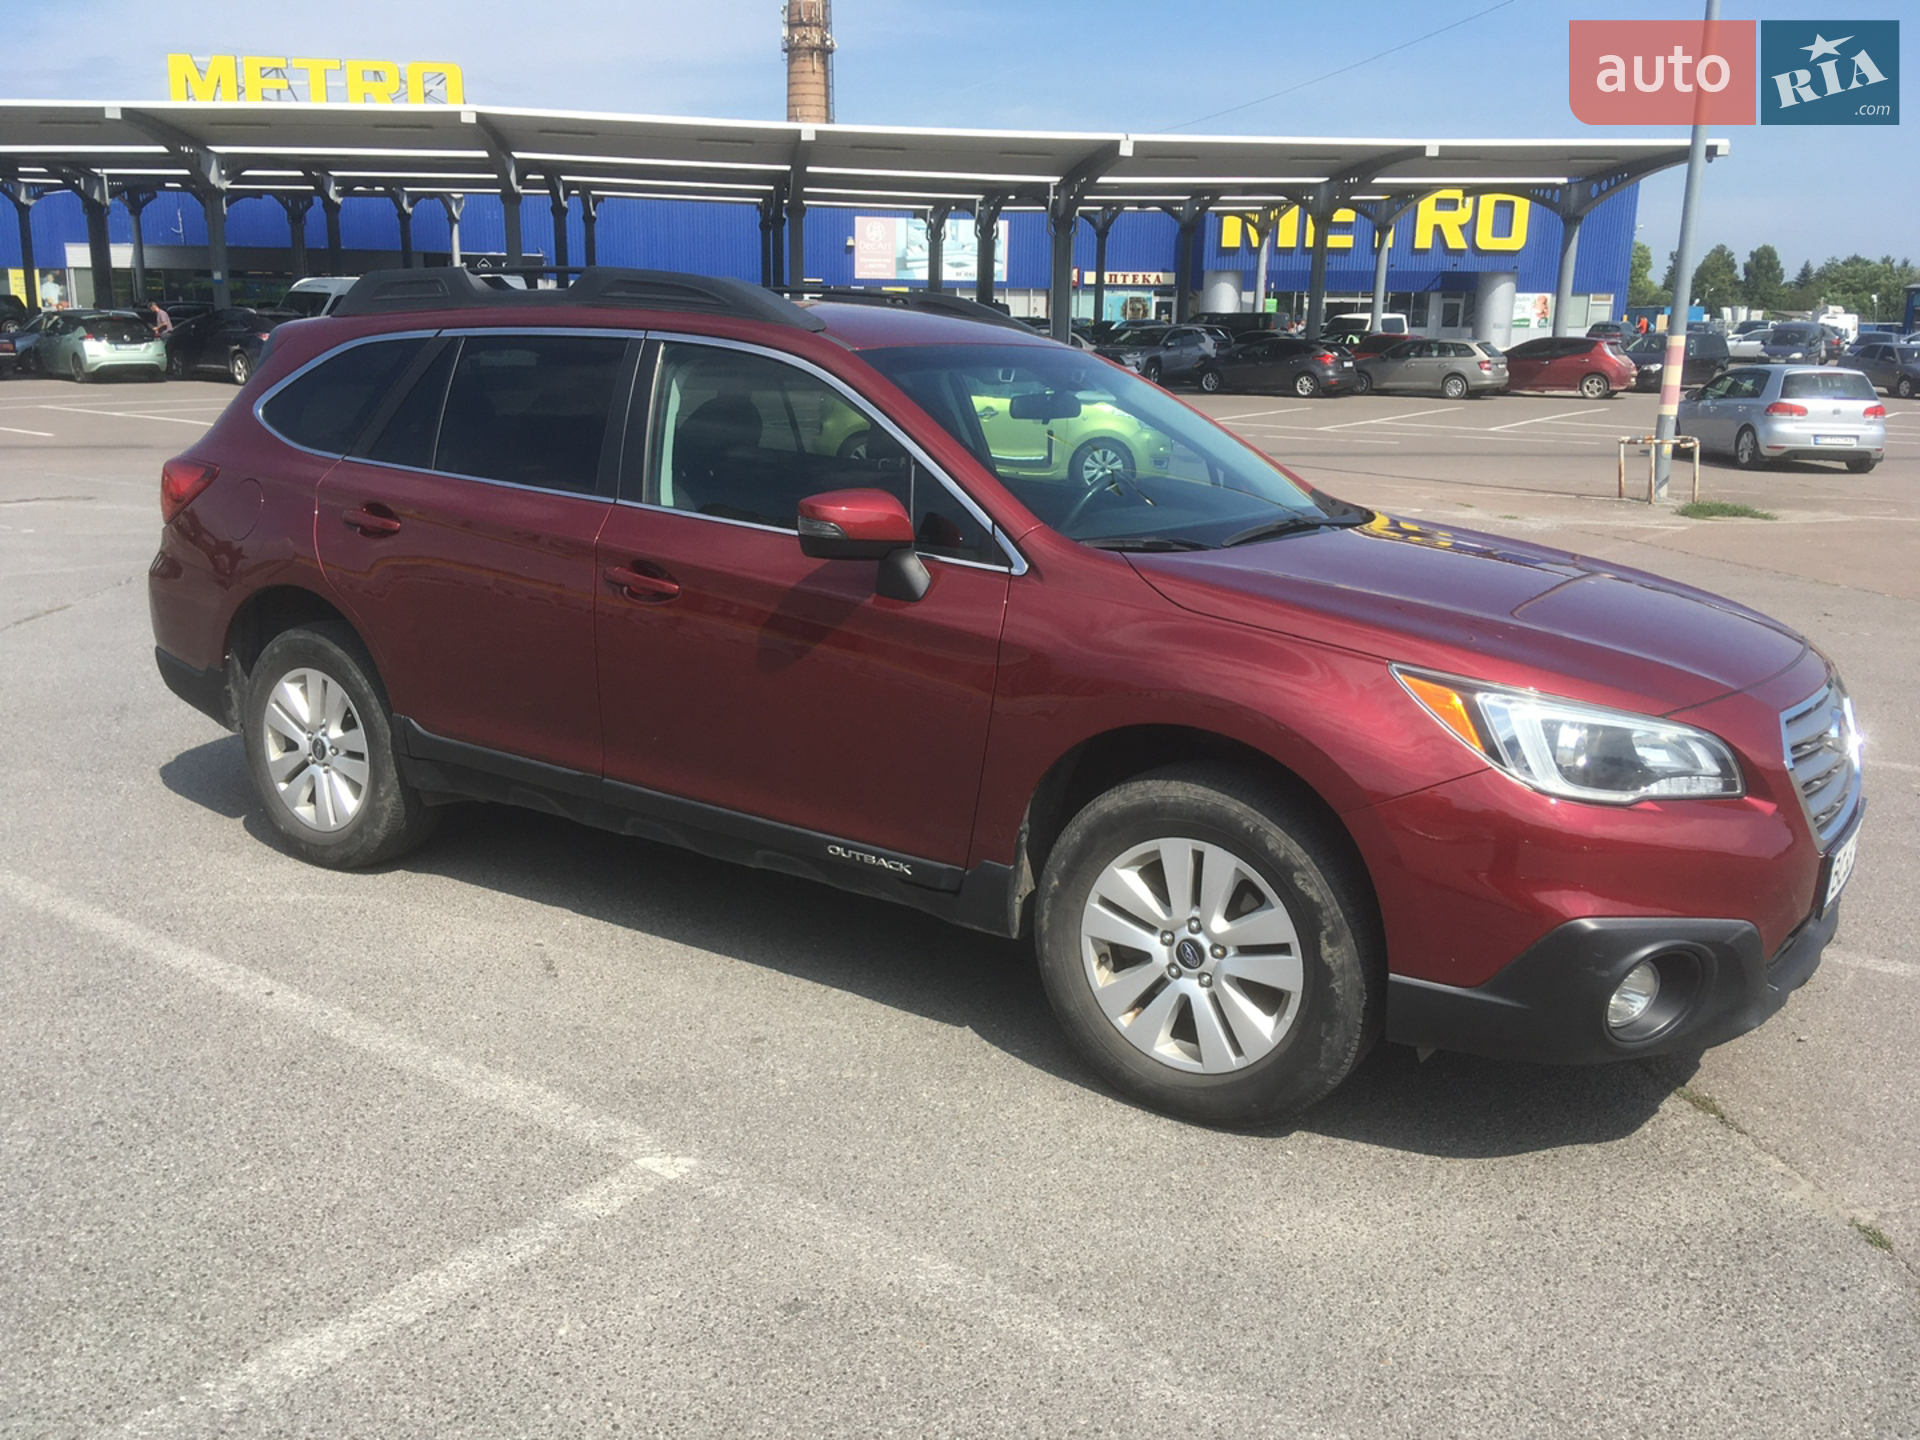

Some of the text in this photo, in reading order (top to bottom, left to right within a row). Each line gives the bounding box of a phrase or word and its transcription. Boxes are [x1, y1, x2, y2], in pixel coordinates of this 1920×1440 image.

[167, 53, 464, 104] METRO
[859, 240, 892, 250] DecArt
[1104, 273, 1162, 284] ПТЕКА
[827, 845, 912, 875] OUTBACK
